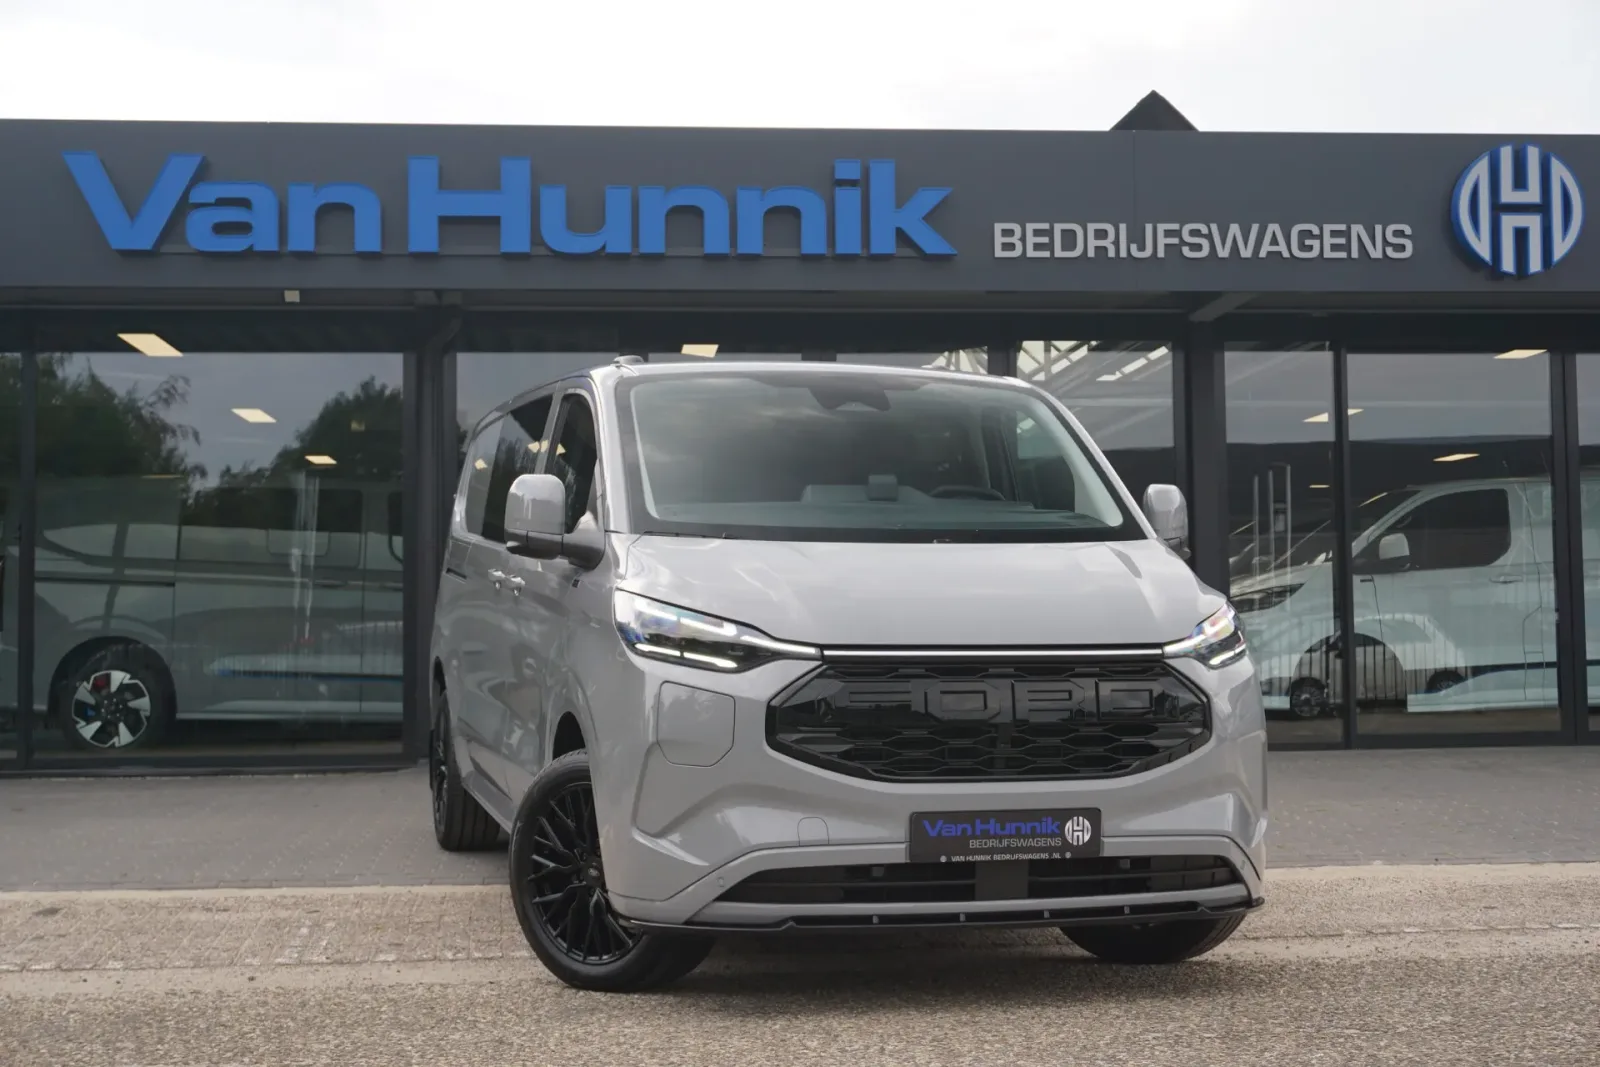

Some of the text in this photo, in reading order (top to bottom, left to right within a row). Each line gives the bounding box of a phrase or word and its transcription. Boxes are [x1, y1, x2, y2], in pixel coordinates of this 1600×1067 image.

[63, 151, 956, 256] Van Hunnik
[993, 222, 1413, 260] BEDRIJFSWAGENS
[923, 816, 1060, 837] Van Hunnik
[969, 837, 1062, 849] BEDRIJFSWAGENS
[993, 852, 1049, 862] BEDRIJFSWAGENS
